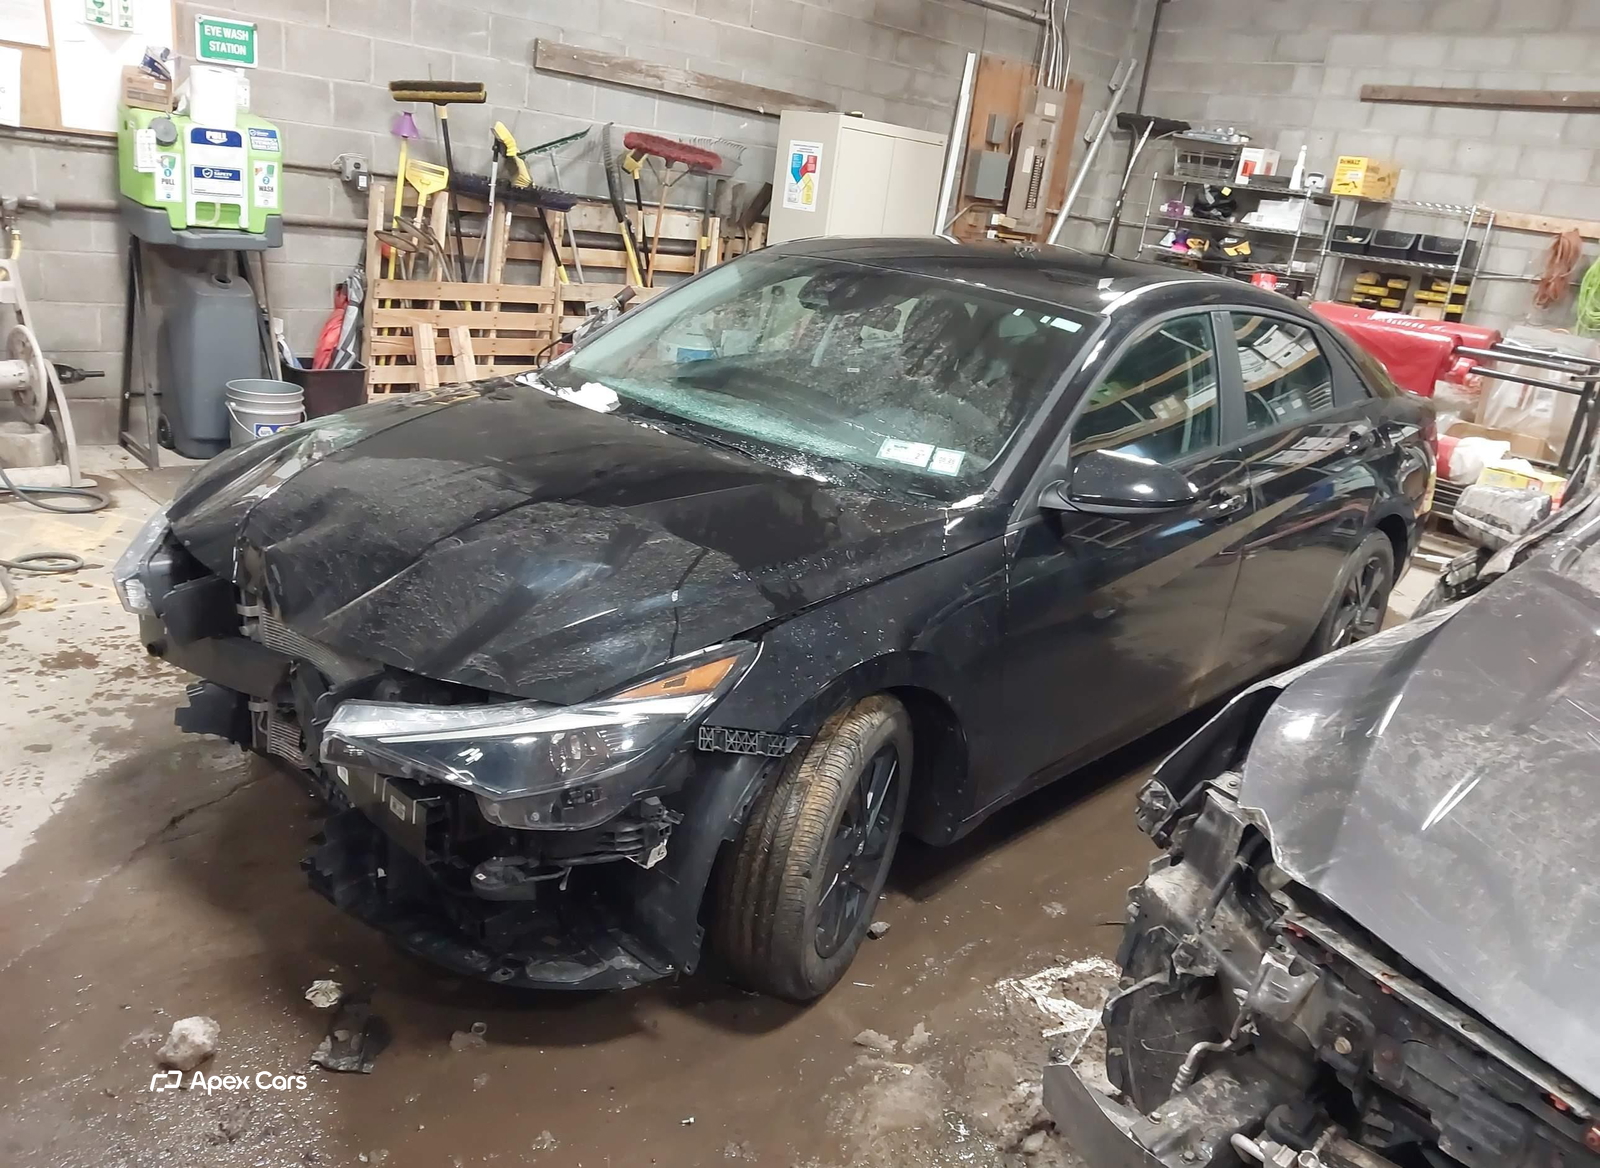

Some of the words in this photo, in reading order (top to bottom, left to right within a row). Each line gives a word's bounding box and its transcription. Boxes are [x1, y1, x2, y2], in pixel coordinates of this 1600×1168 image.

[204, 24, 222, 37] EYE
[223, 27, 249, 41] WASH
[209, 40, 246, 55] STATION
